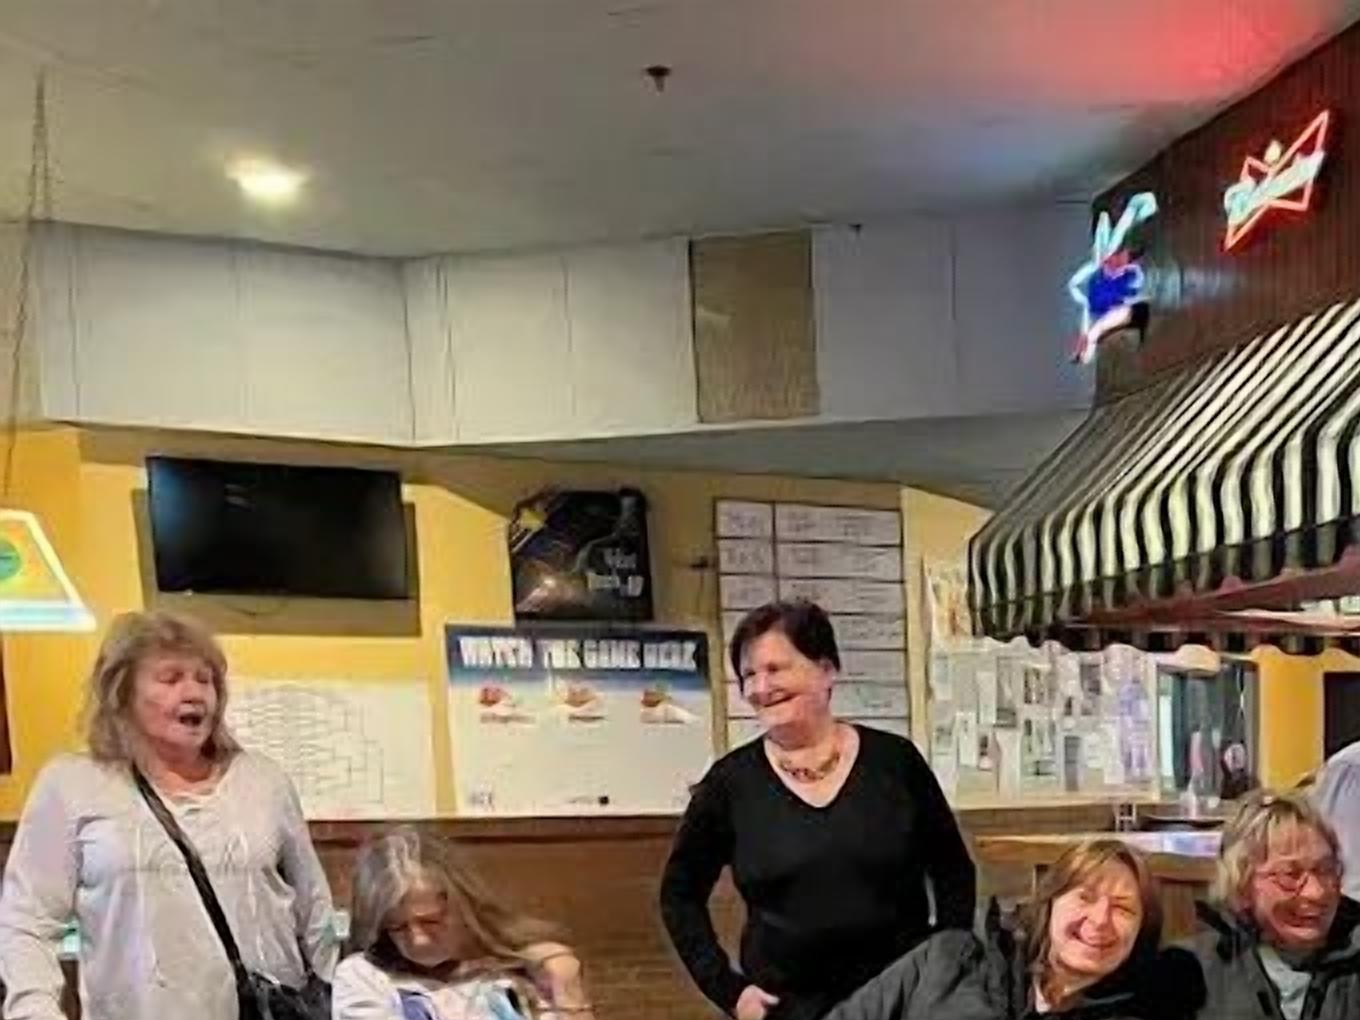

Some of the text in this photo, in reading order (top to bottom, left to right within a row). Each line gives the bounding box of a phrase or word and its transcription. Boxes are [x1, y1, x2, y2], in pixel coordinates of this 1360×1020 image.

[458, 635, 535, 669] WATCH
[537, 638, 583, 670] THE
[583, 639, 642, 670] GAME
